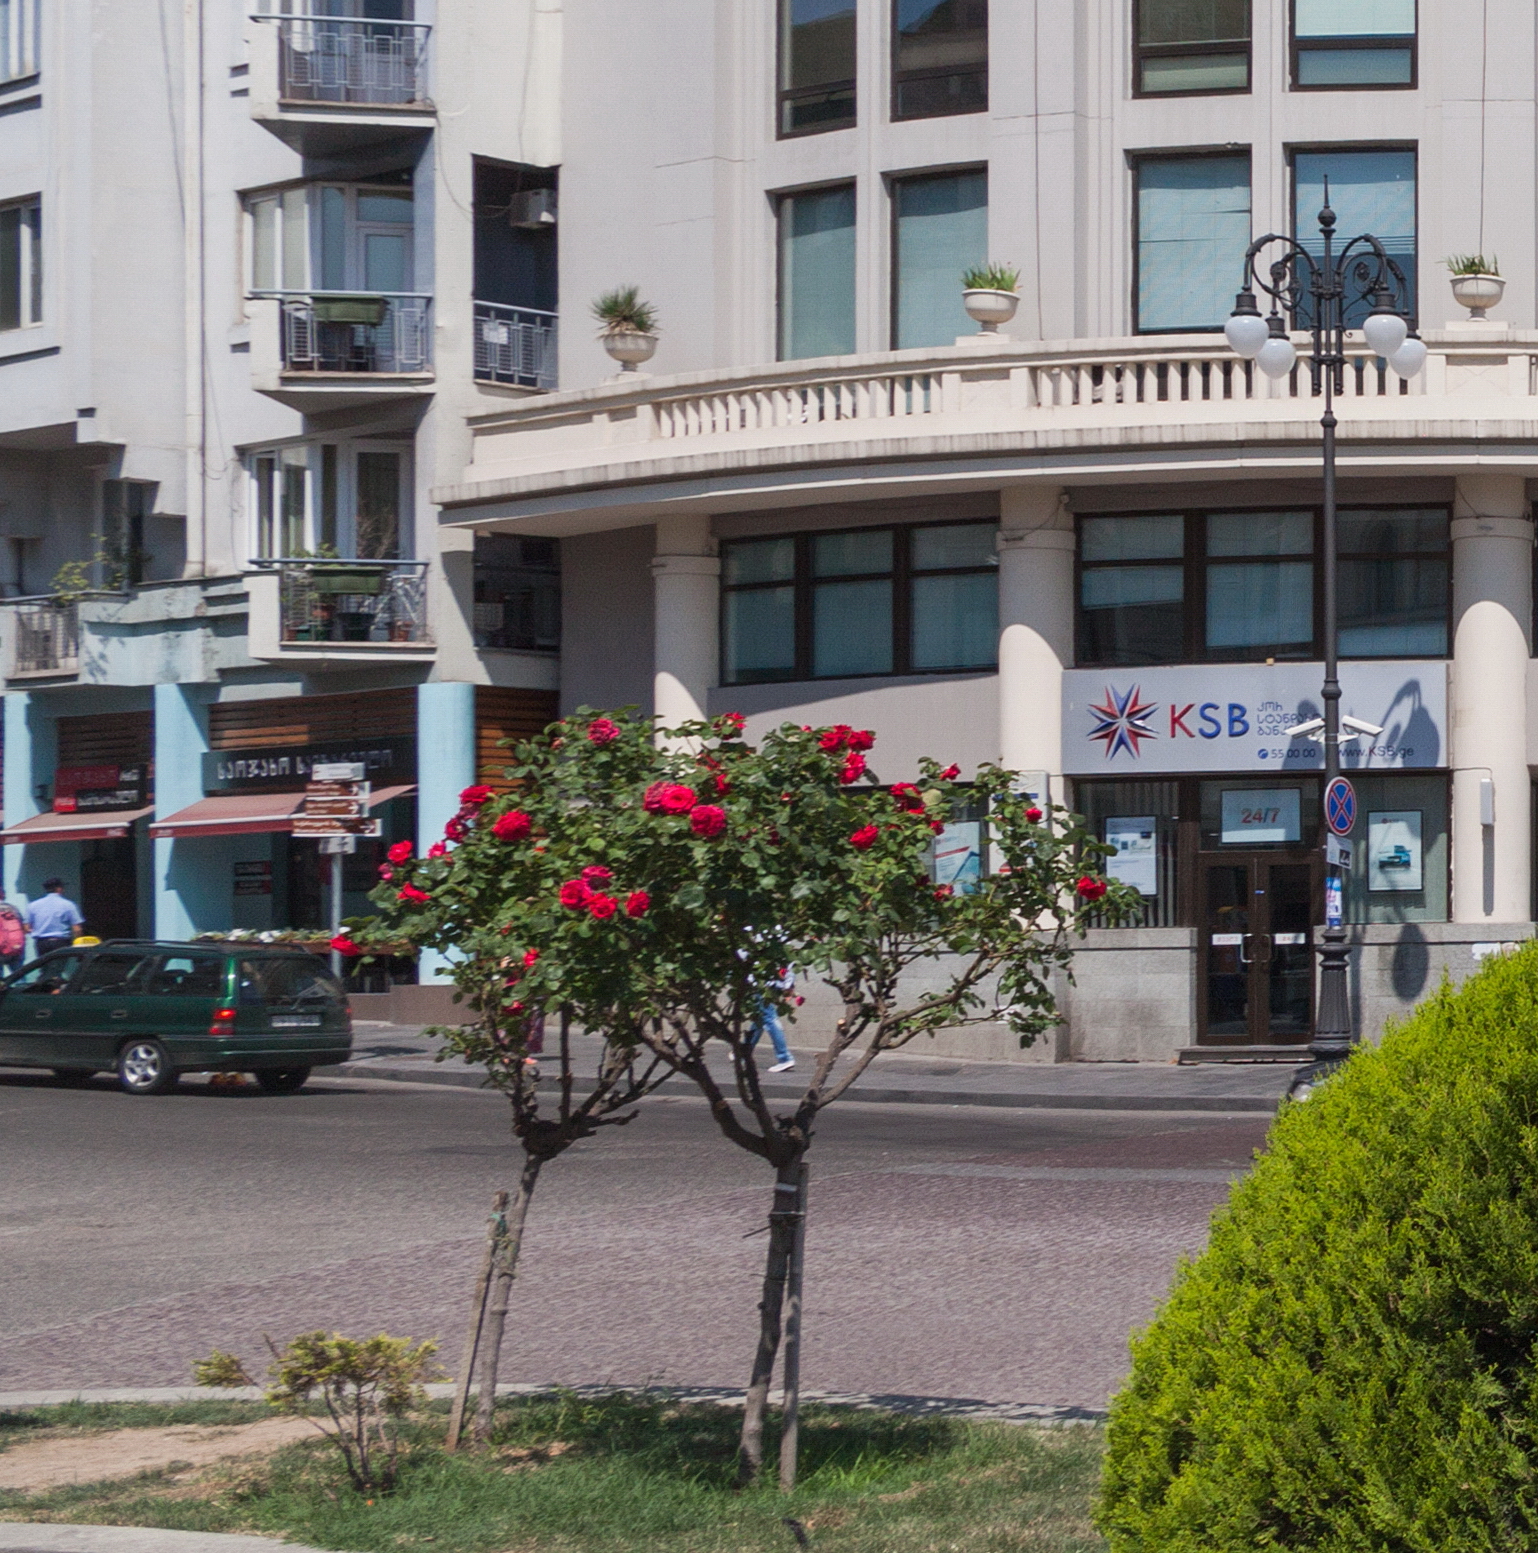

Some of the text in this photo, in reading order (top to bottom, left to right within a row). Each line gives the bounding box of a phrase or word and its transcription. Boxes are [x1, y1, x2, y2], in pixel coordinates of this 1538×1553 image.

[1169, 702, 1251, 739] KSB
[1270, 746, 1317, 759] 55 00 00
[1240, 807, 1281, 824] 24/7
